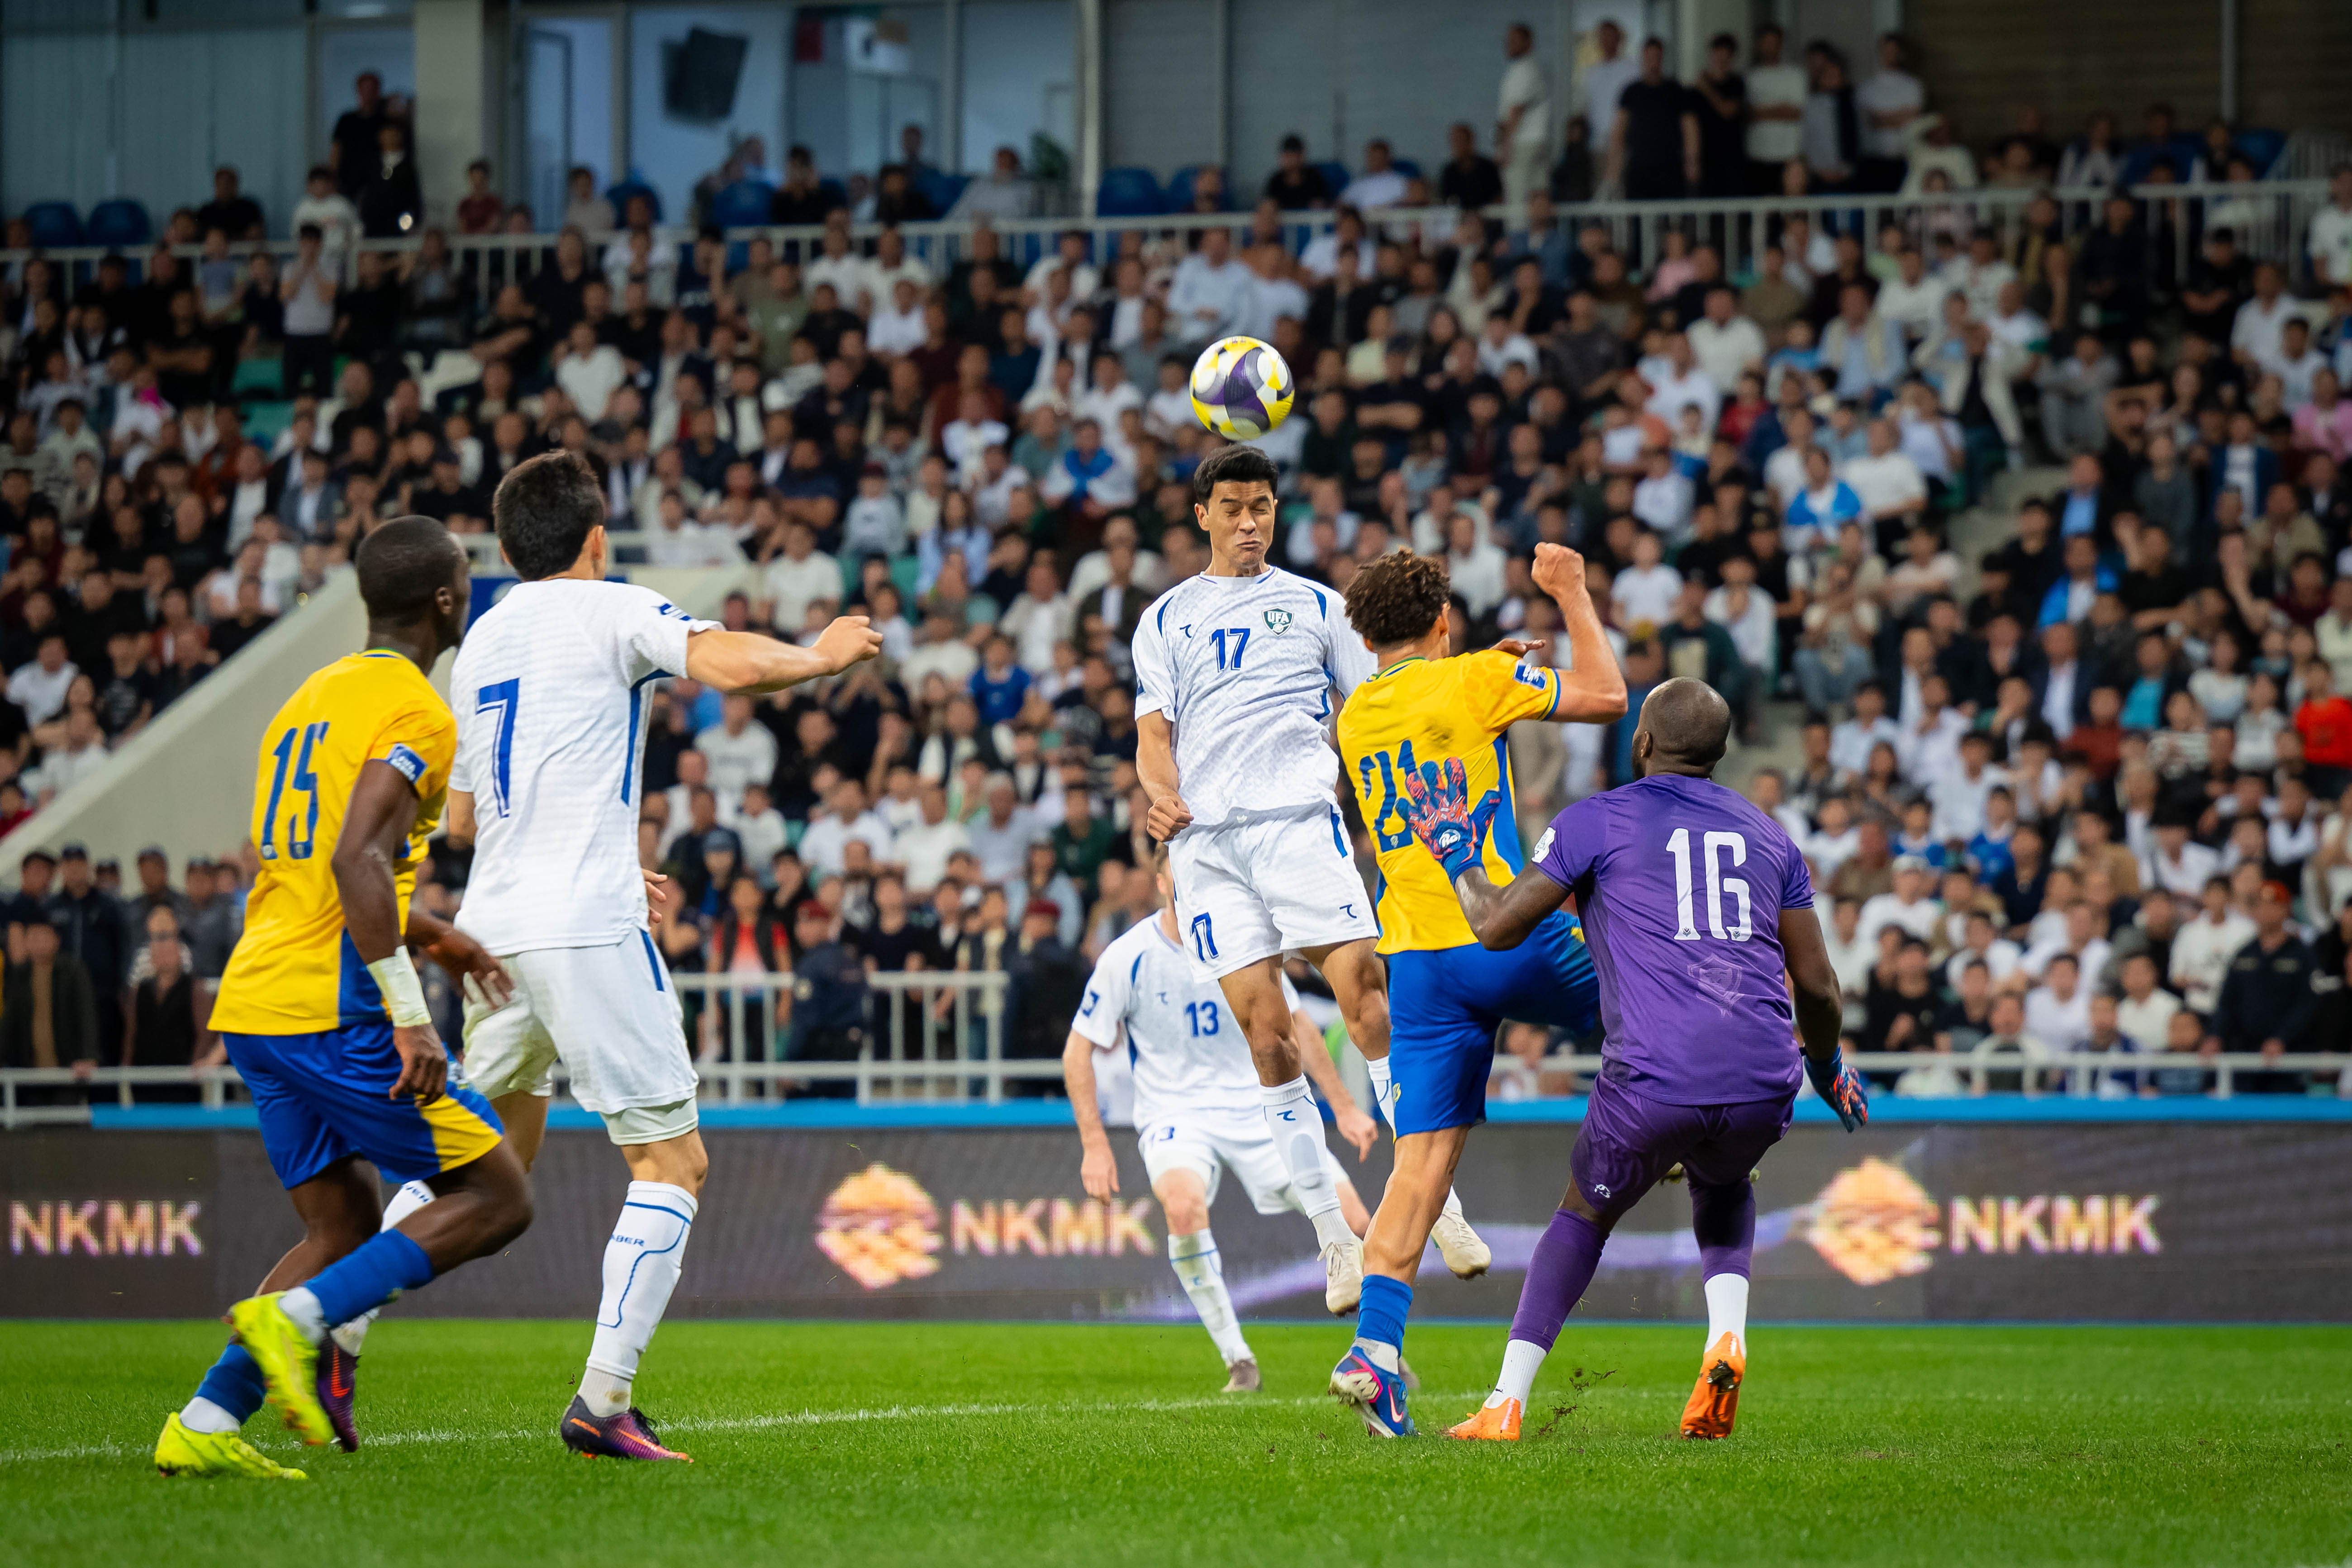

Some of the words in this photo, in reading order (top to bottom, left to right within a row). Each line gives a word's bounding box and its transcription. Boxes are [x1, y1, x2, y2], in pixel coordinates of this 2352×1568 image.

[1267, 611, 1289, 623] UFA
[1209, 627, 1250, 673] 17
[475, 677, 520, 818] 7
[261, 722, 330, 860] 15
[1666, 828, 1753, 942] 16
[1184, 1000, 1220, 1037] 13
[9, 1199, 203, 1256] NKMK
[951, 1197, 1157, 1258] NKMK
[1949, 1194, 2162, 1255] NKMK
